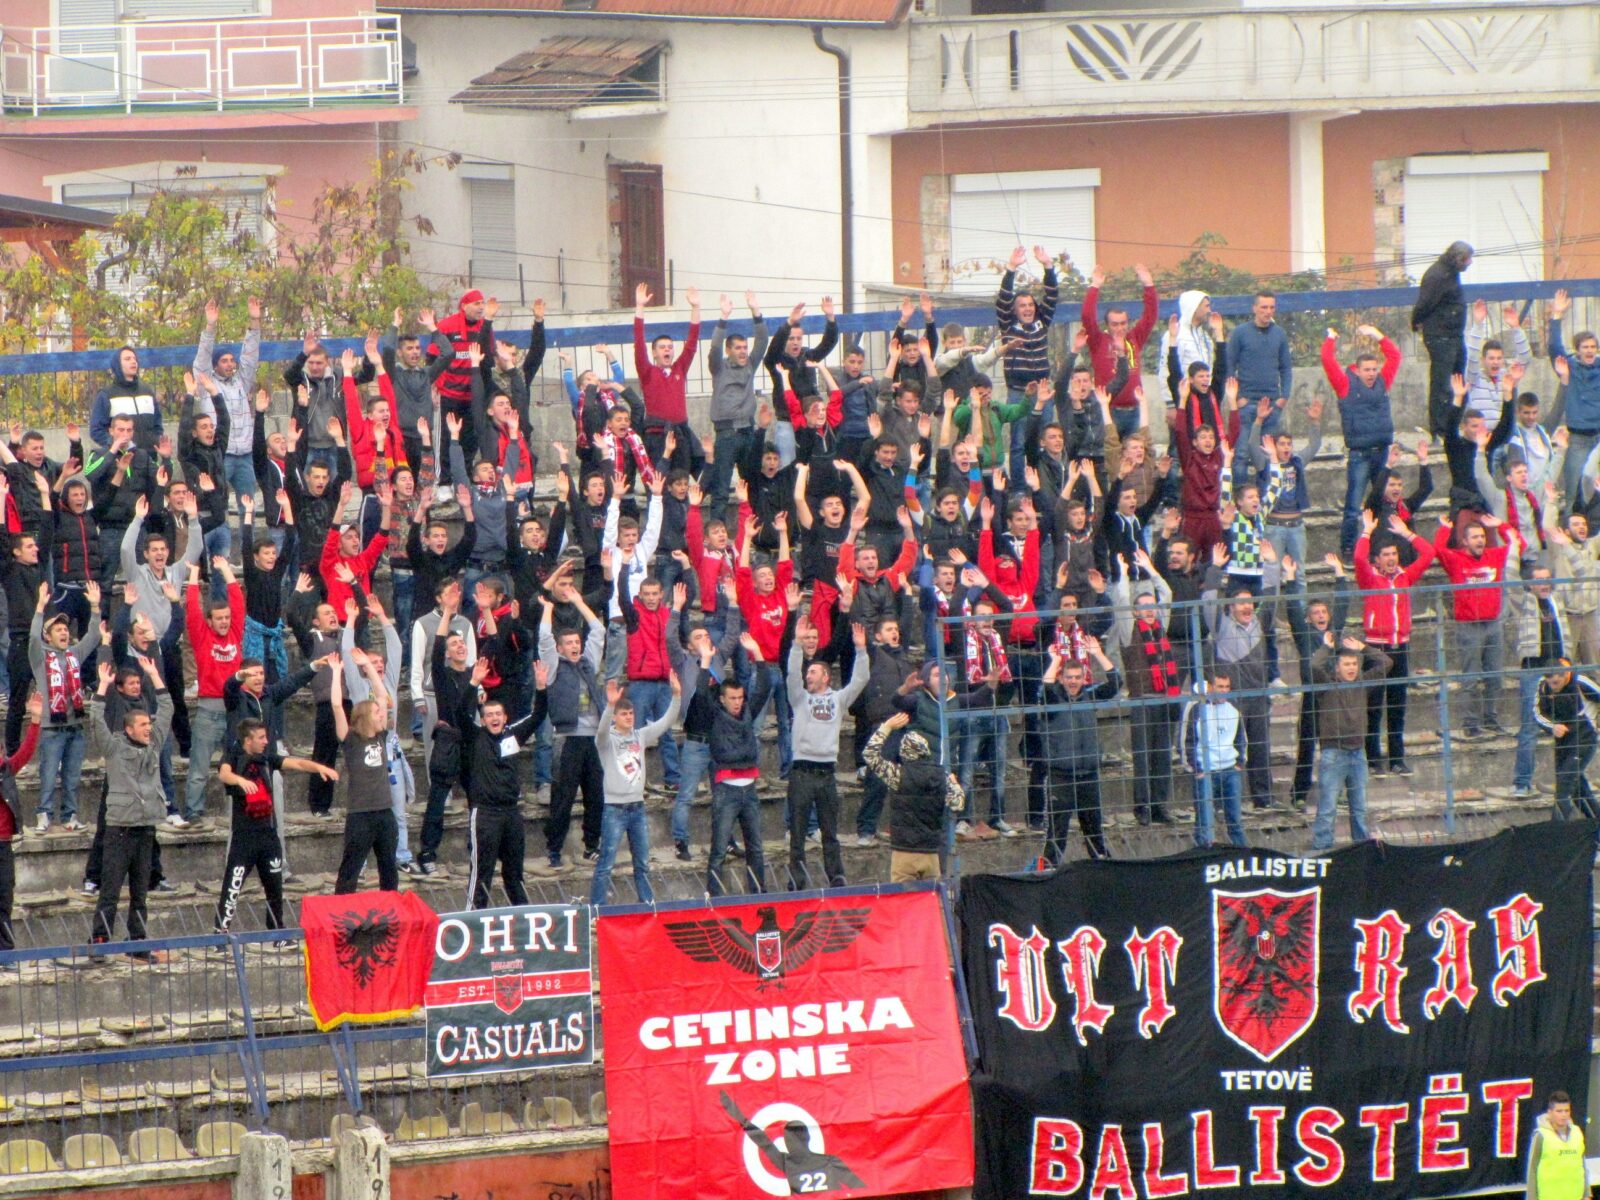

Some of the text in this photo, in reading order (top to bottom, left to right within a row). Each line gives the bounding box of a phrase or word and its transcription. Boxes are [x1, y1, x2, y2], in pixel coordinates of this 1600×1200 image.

[1206, 856, 1333, 883] BALLISTET
[435, 909, 579, 963] OHRI
[458, 978, 561, 998] EST. 1992
[435, 1011, 586, 1065] CASUALS
[639, 997, 914, 1050] CETINSKA
[704, 1043, 852, 1086] ZONE
[1220, 1066, 1314, 1092] TETOVË
[1029, 1073, 1534, 1200] BALLISTËT
[799, 1172, 829, 1193] 22
